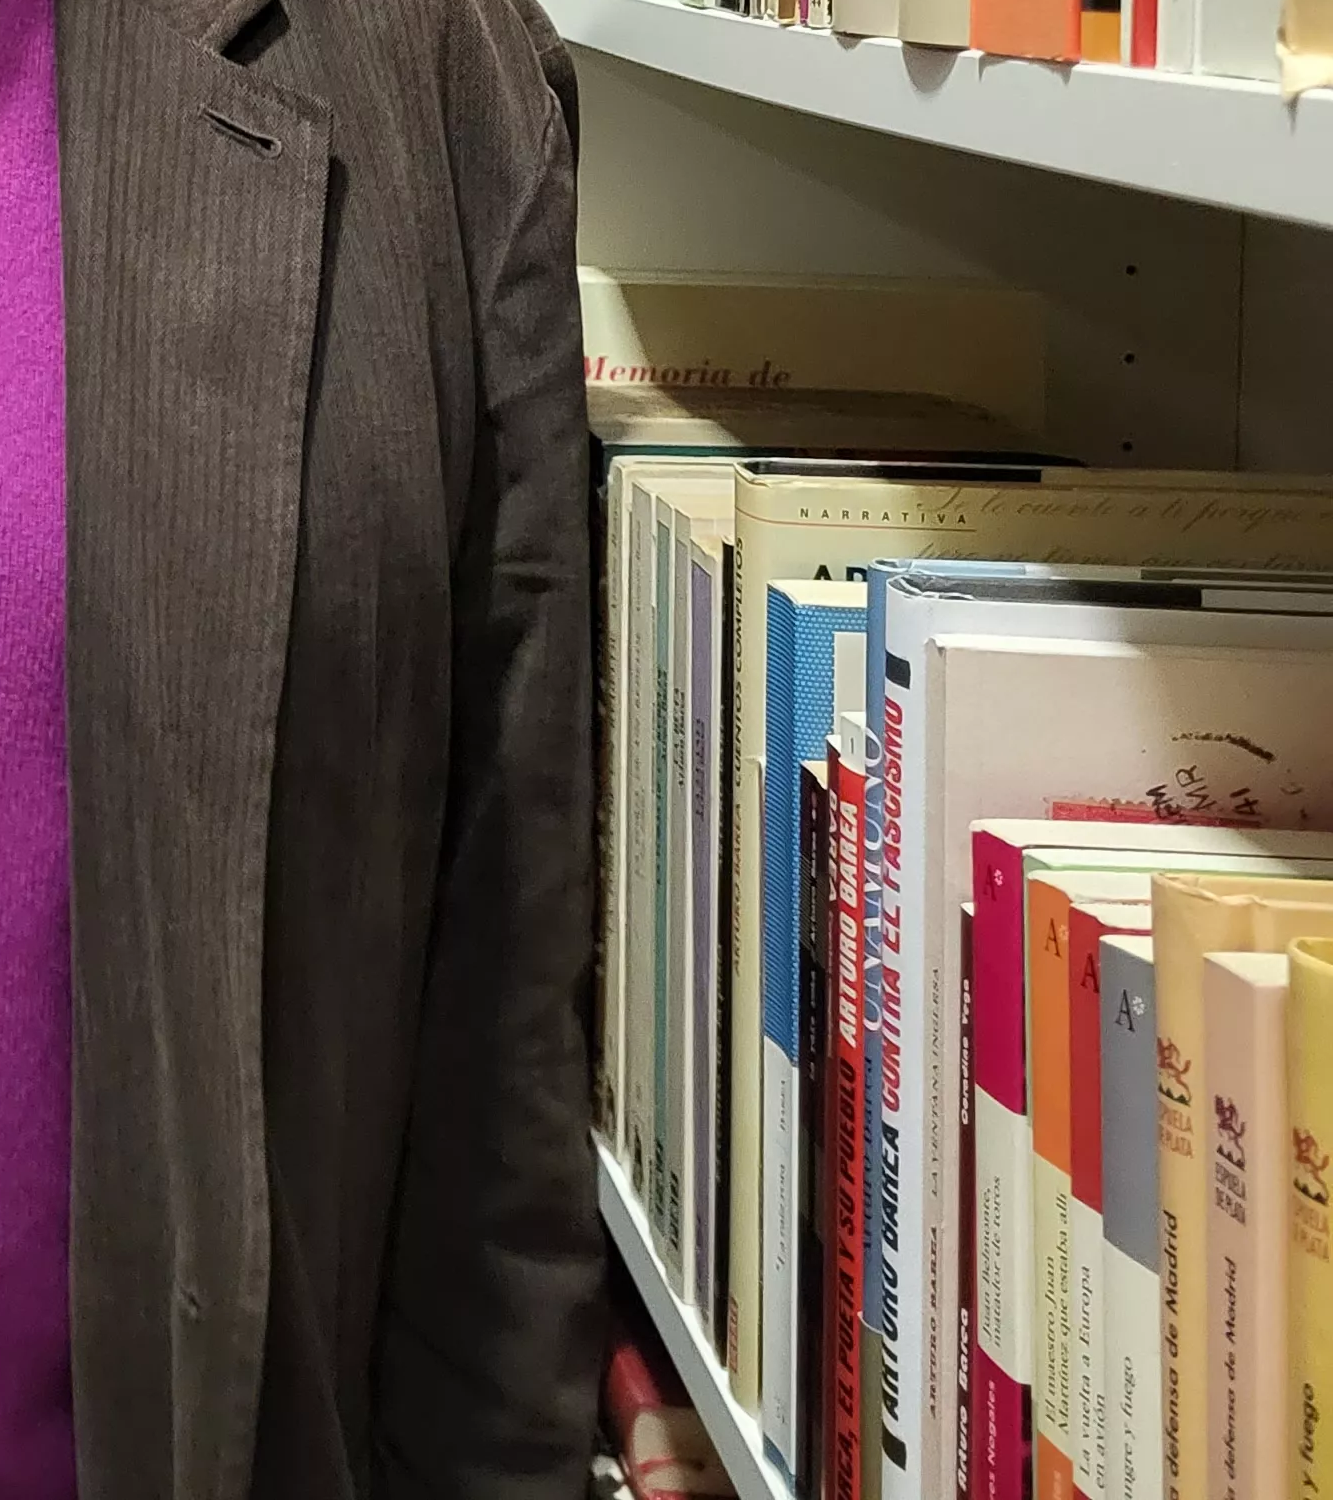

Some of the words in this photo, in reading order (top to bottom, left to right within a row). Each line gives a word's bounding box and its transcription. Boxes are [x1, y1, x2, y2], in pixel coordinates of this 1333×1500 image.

[582, 355, 731, 390] Memoria
[748, 363, 791, 390] de
[799, 507, 968, 526] NARRATIVA
[884, 695, 904, 893] FASCISMO
[839, 801, 859, 910] BAREA
[862, 726, 882, 1034] UNAMUNO
[884, 901, 902, 956] EL
[839, 912, 858, 1050] ARTURO
[1115, 988, 1135, 1033] A
[882, 967, 902, 1113] CONTRA
[981, 1187, 994, 1286] Belmonte,
[1056, 1190, 1069, 1224] allí
[1057, 1230, 1071, 1294] estaba
[1162, 1210, 1180, 1316] Madrid
[1223, 1257, 1238, 1344] Madrid
[881, 1256, 901, 1422] ARTURO
[980, 1290, 992, 1340] Juan
[1059, 1298, 1072, 1338] que
[1165, 1323, 1179, 1358] de
[1057, 1342, 1071, 1435] Martínez
[1224, 1350, 1237, 1381] de
[986, 1380, 998, 1467] Nogales
[1092, 1393, 1107, 1459] avión
[1164, 1366, 1180, 1477] defensa
[1223, 1386, 1237, 1483] defensa
[1095, 1465, 1105, 1491] en
